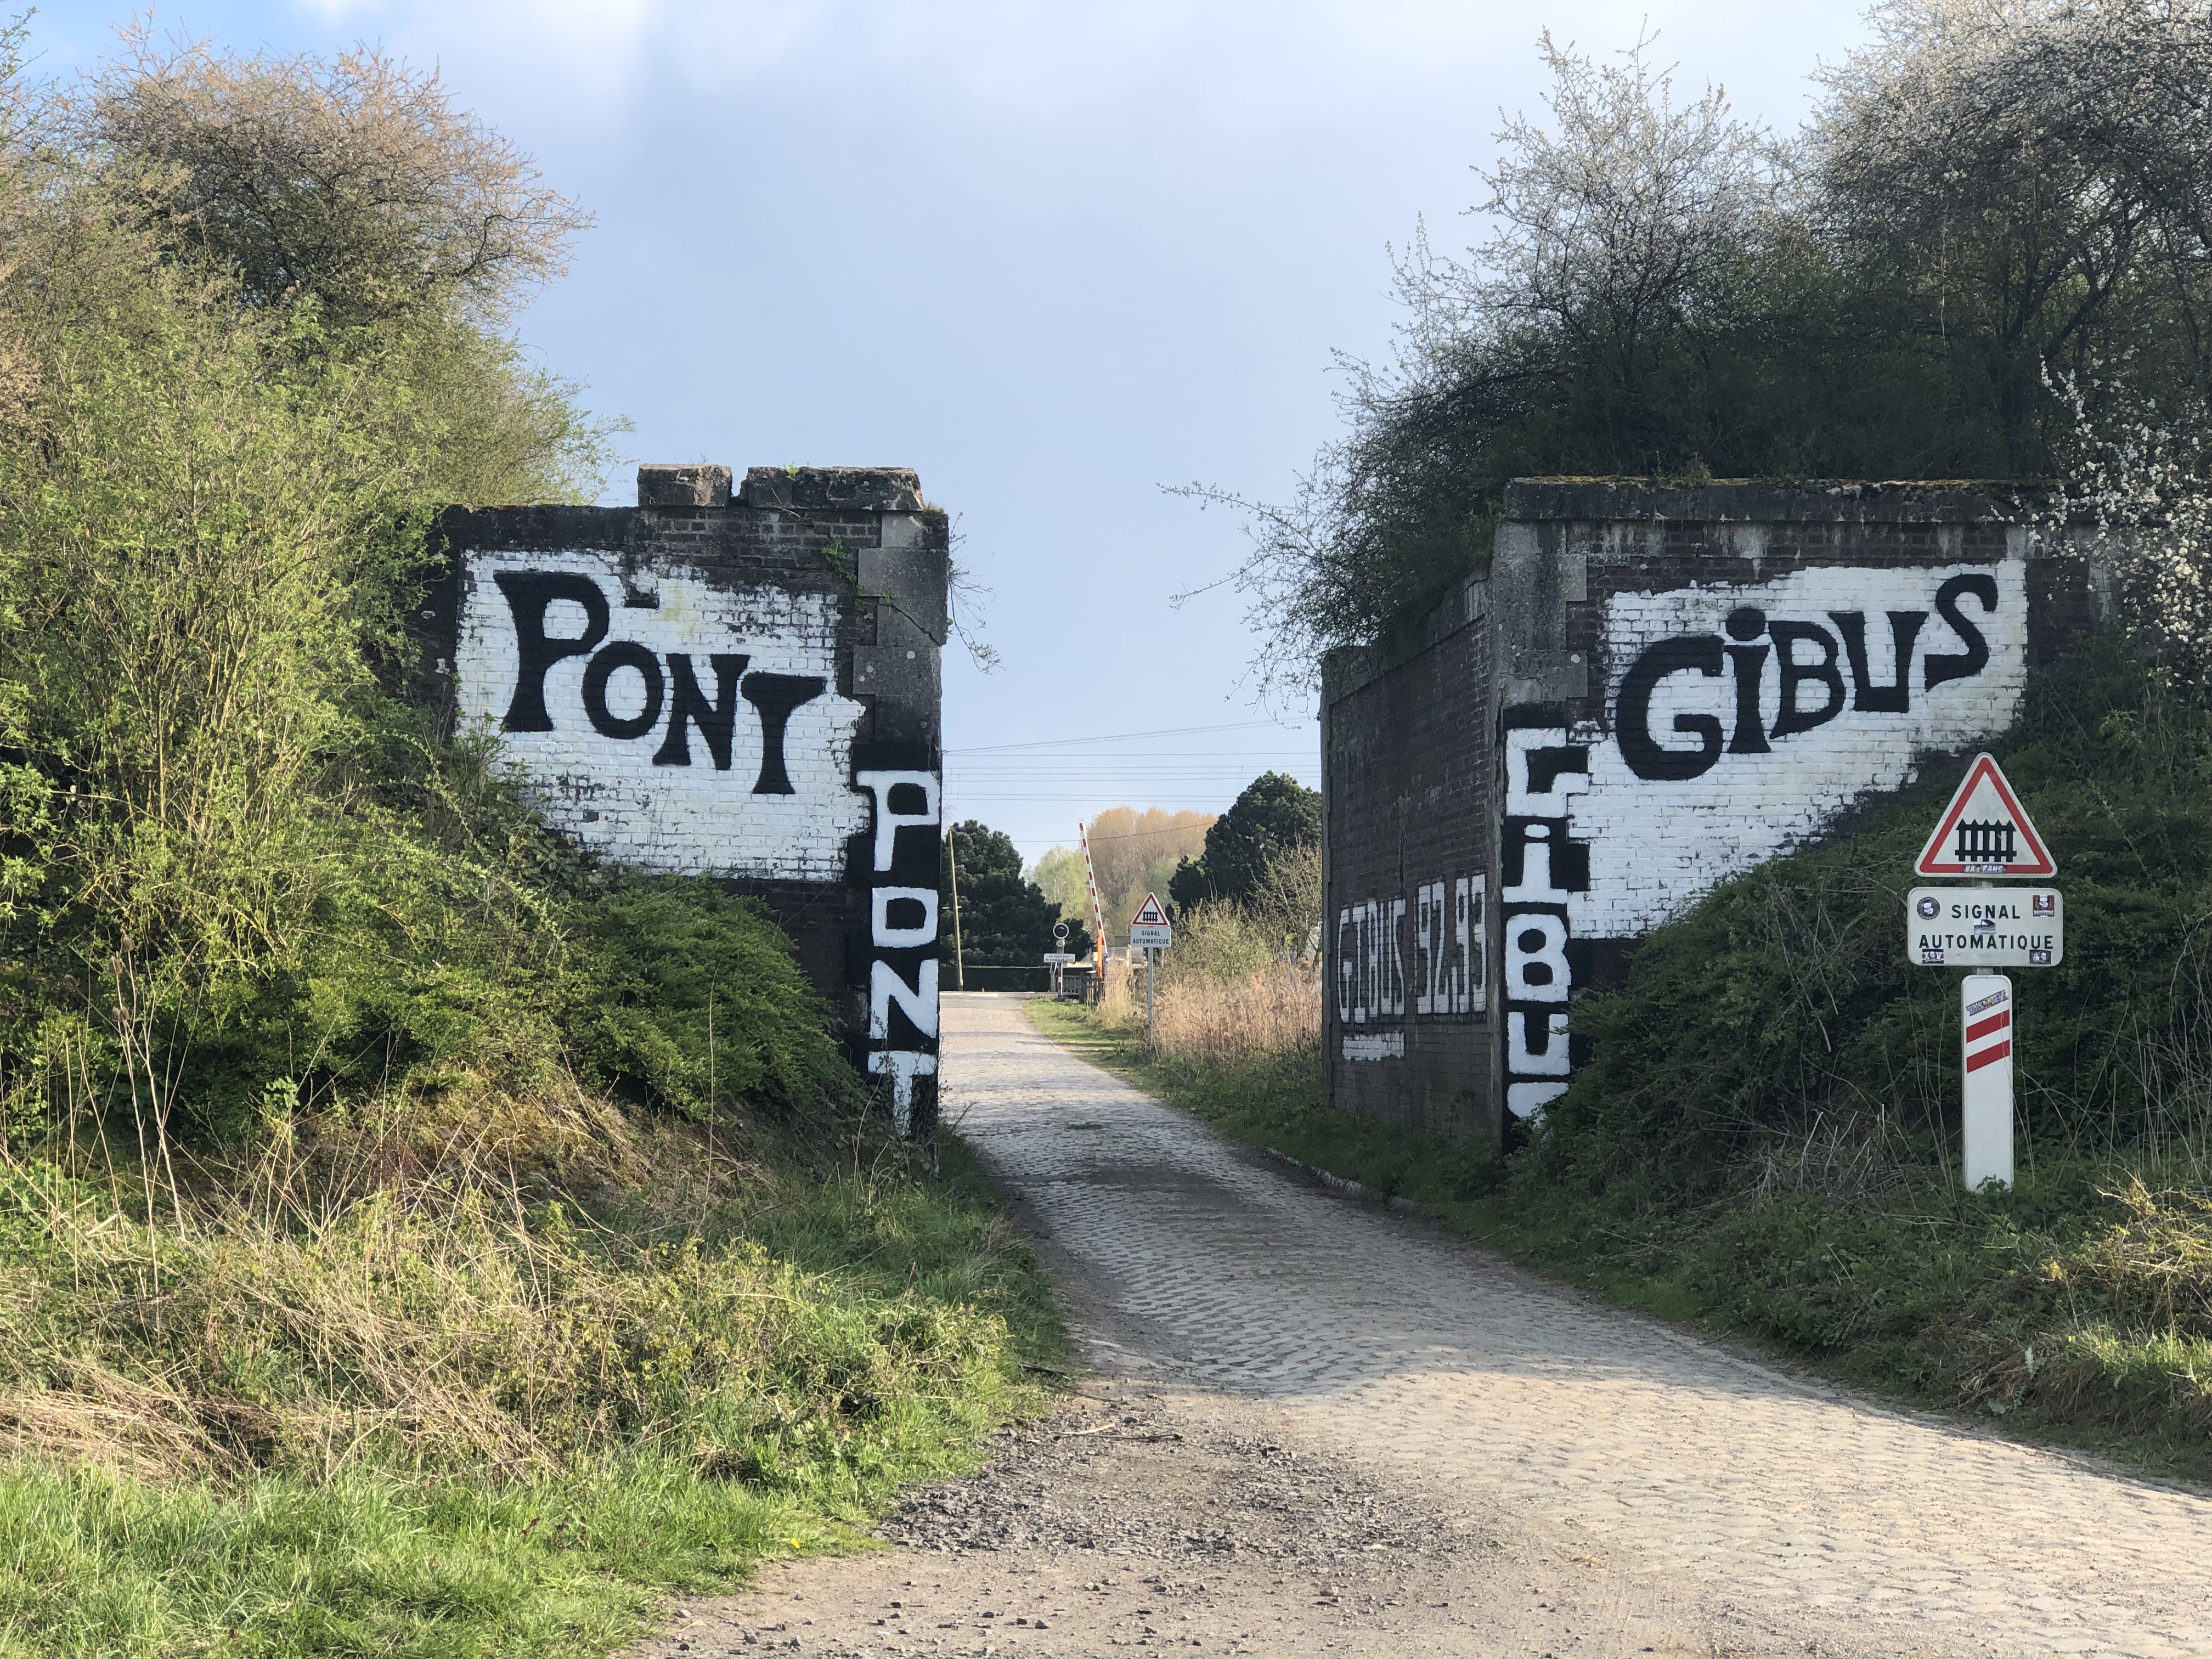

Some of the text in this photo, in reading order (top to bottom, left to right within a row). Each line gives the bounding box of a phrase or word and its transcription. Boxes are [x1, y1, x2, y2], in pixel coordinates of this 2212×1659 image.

[494, 571, 826, 794] PONT
[1951, 905, 2021, 919] SIGNAL
[1919, 935, 2053, 950] AUTOMATIQUE
